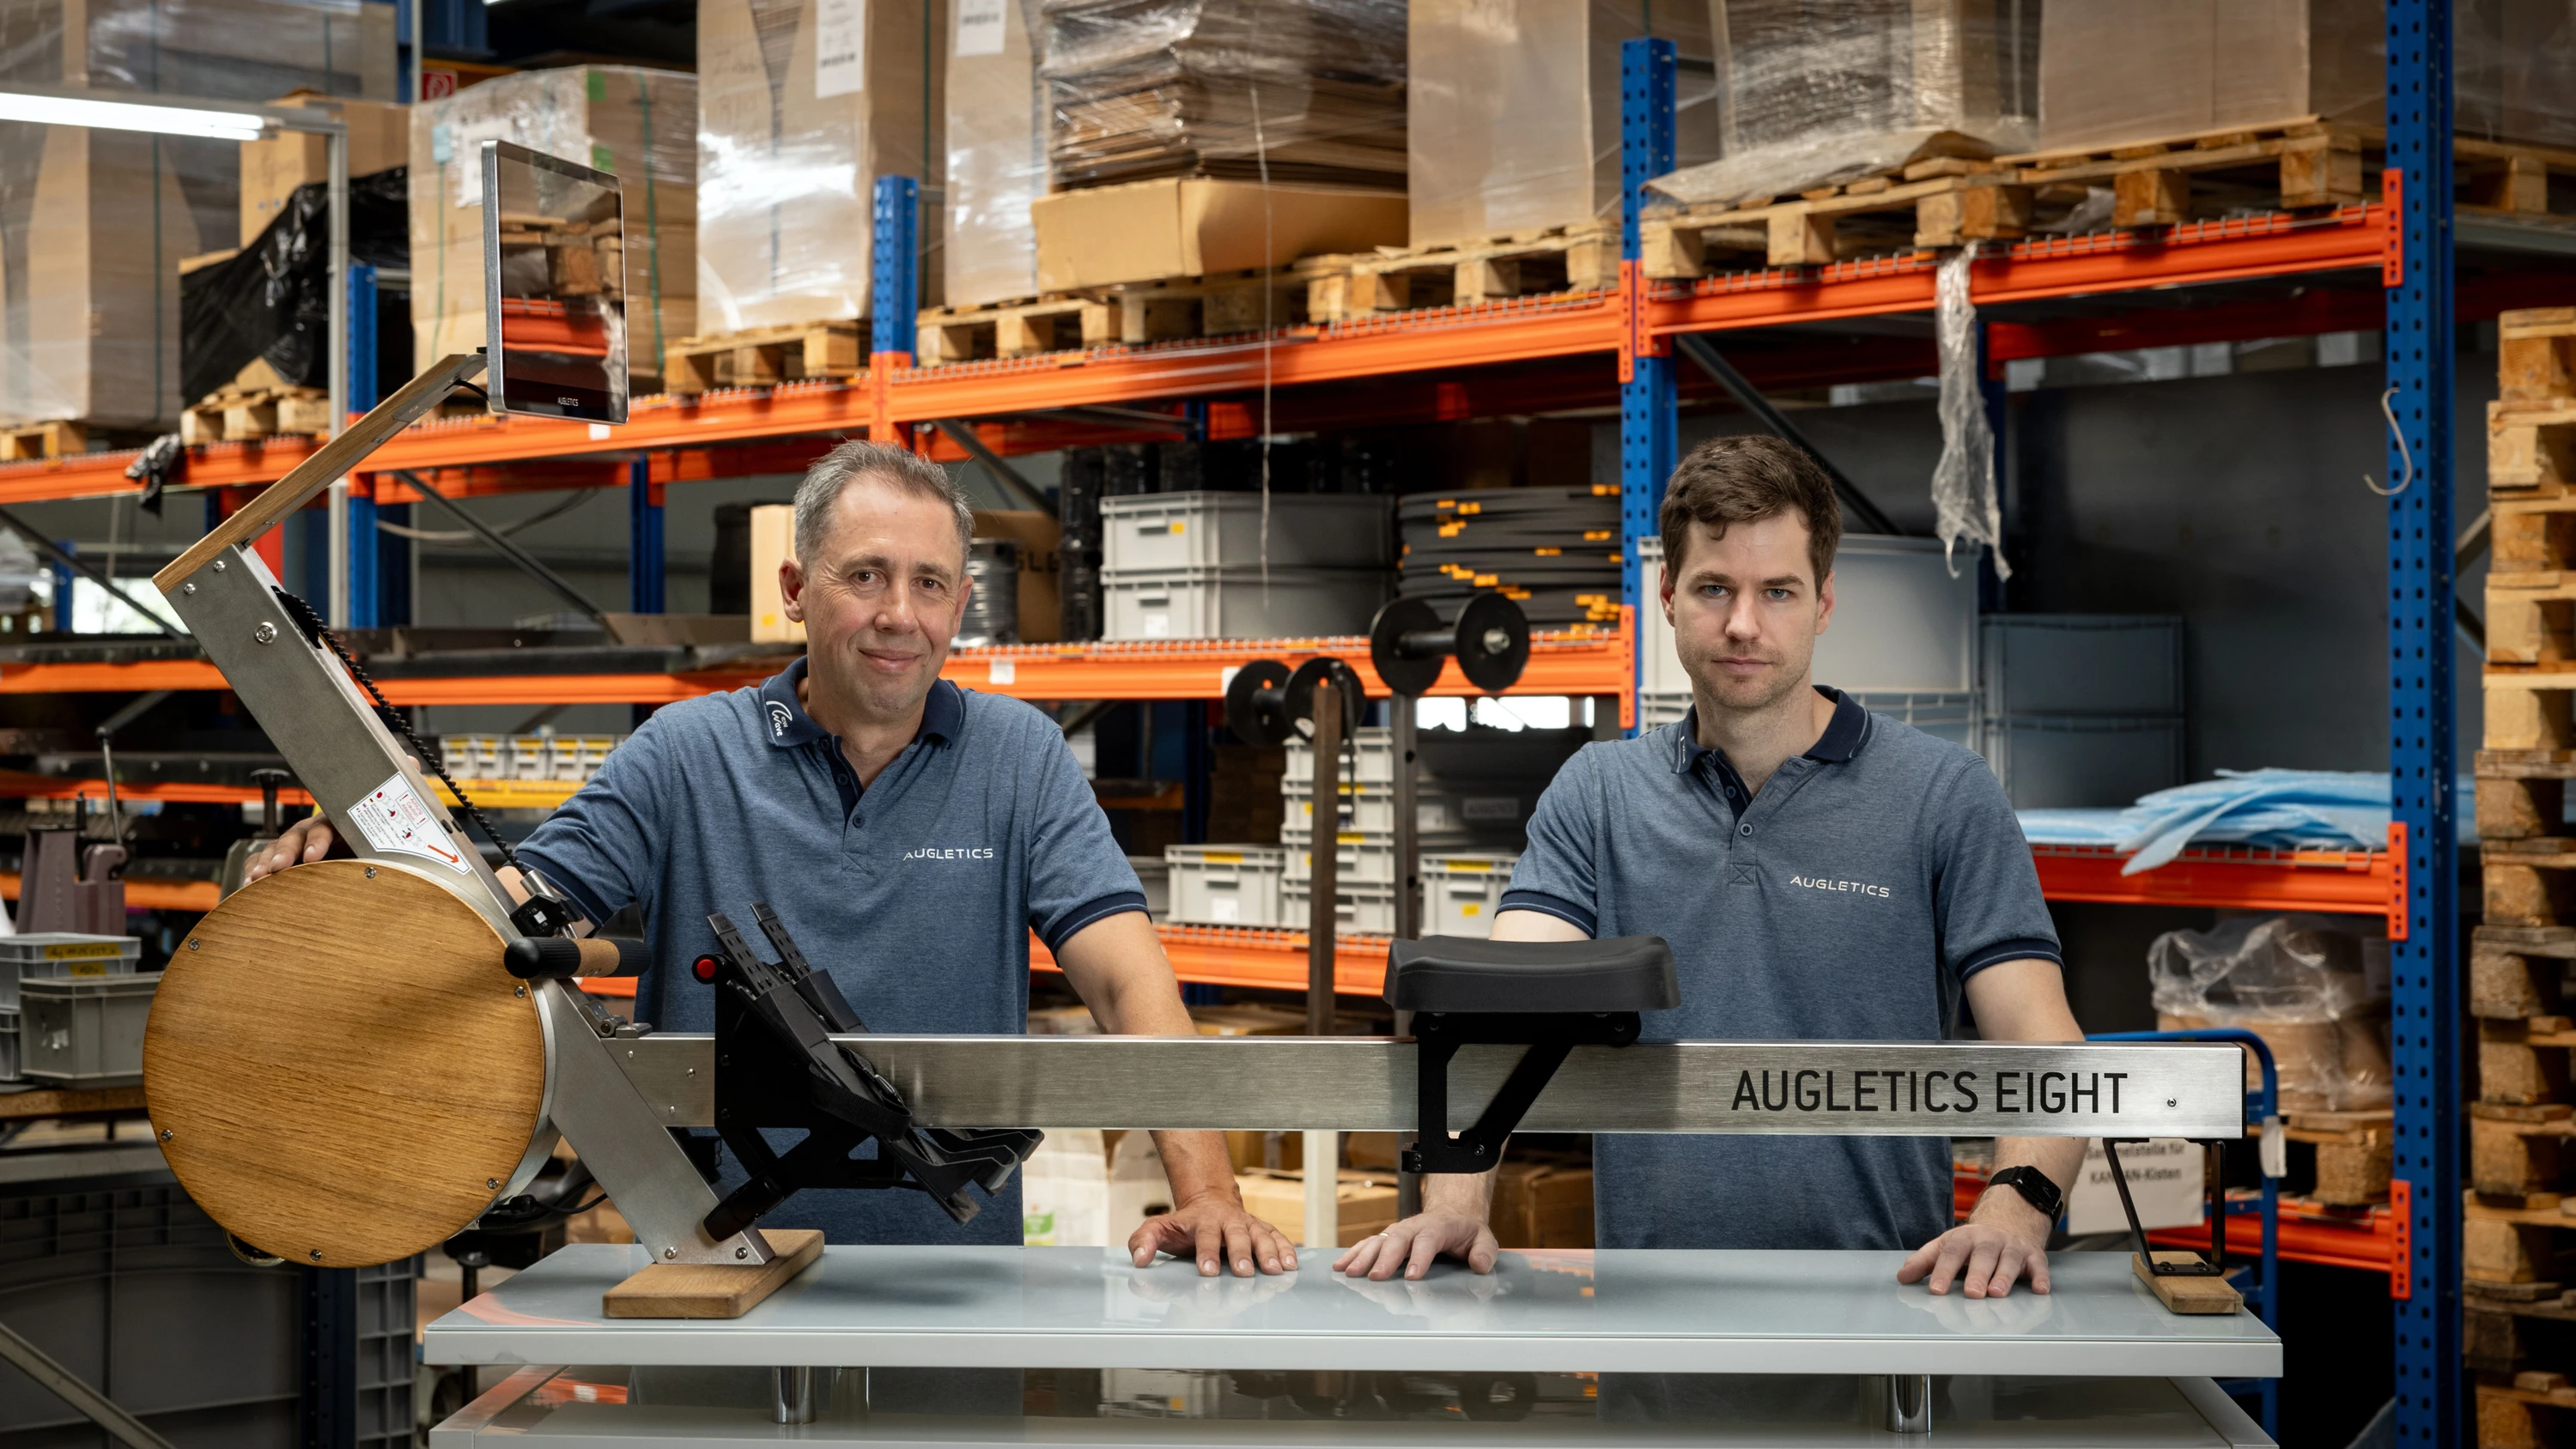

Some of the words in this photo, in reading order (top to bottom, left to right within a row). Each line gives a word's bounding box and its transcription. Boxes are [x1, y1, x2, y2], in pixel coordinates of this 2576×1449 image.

[903, 848, 993, 861] AUGLETICS
[1789, 876, 1890, 898] AUGLETICS
[1731, 1070, 1978, 1113] AUGLETICS
[1996, 1071, 2128, 1114] EIGHT
[2091, 1168, 2181, 1184] KANAN-Kisten
